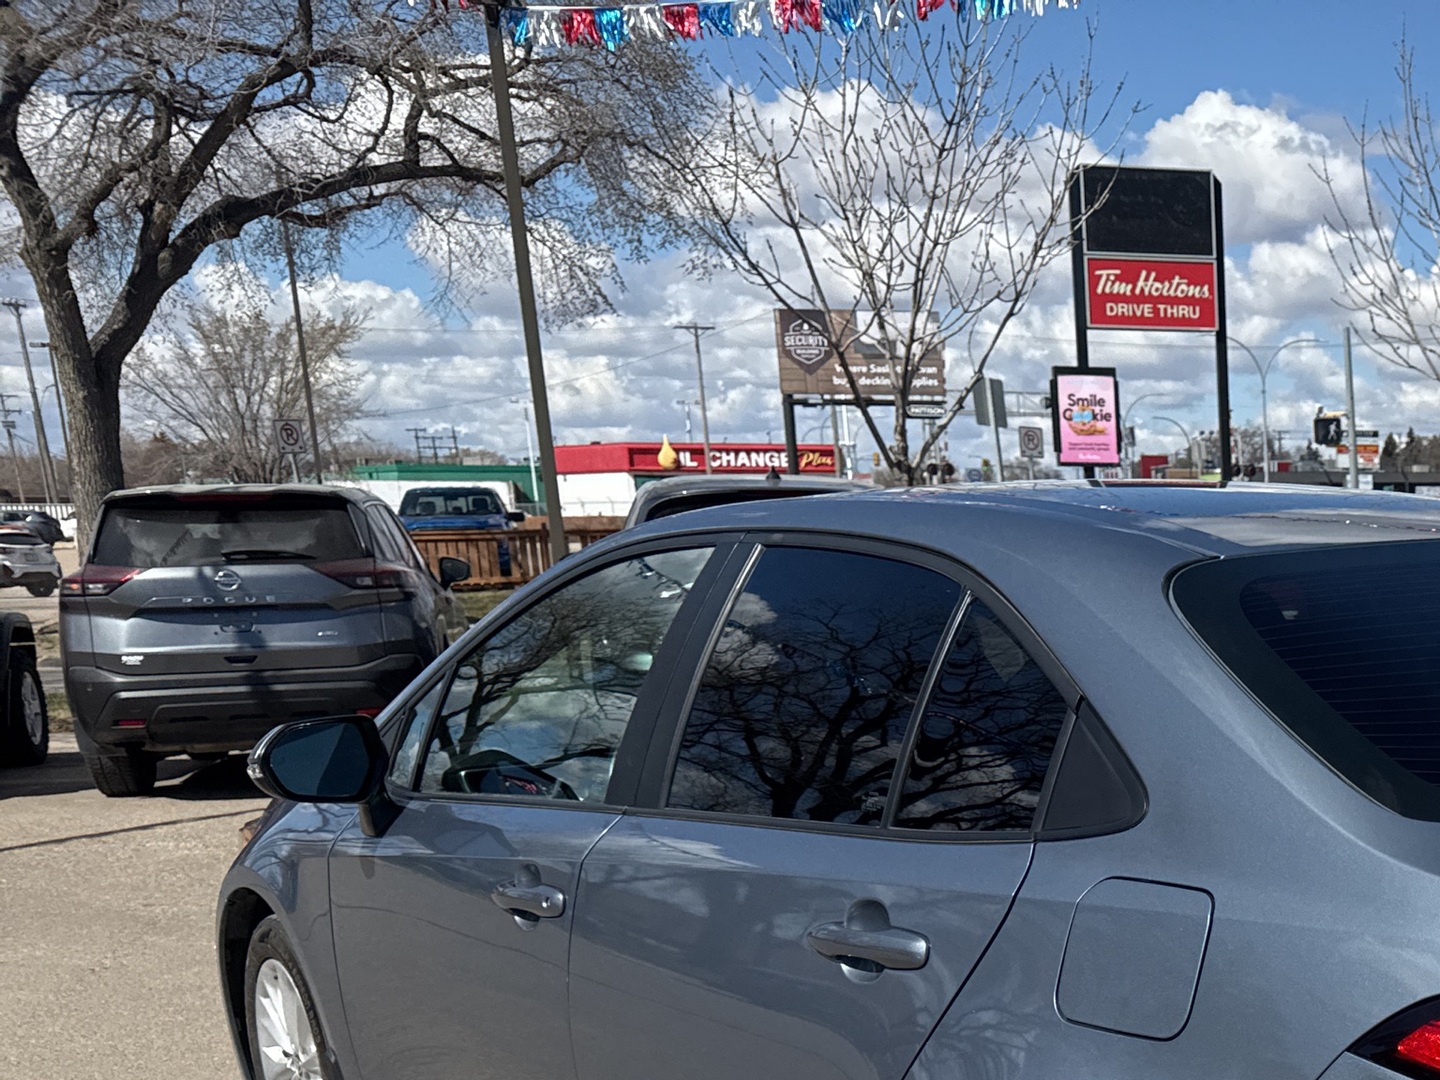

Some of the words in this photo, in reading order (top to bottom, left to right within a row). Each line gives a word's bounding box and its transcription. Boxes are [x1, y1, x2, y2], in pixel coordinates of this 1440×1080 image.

[1094, 269, 1133, 296] Tim
[1134, 269, 1210, 299] Hortons
[1105, 302, 1154, 317] DRIVE
[1156, 304, 1201, 319] THRU
[784, 335, 829, 347] SECURITY
[1067, 393, 1106, 407] Smile
[181, 594, 276, 603] ROGUE
